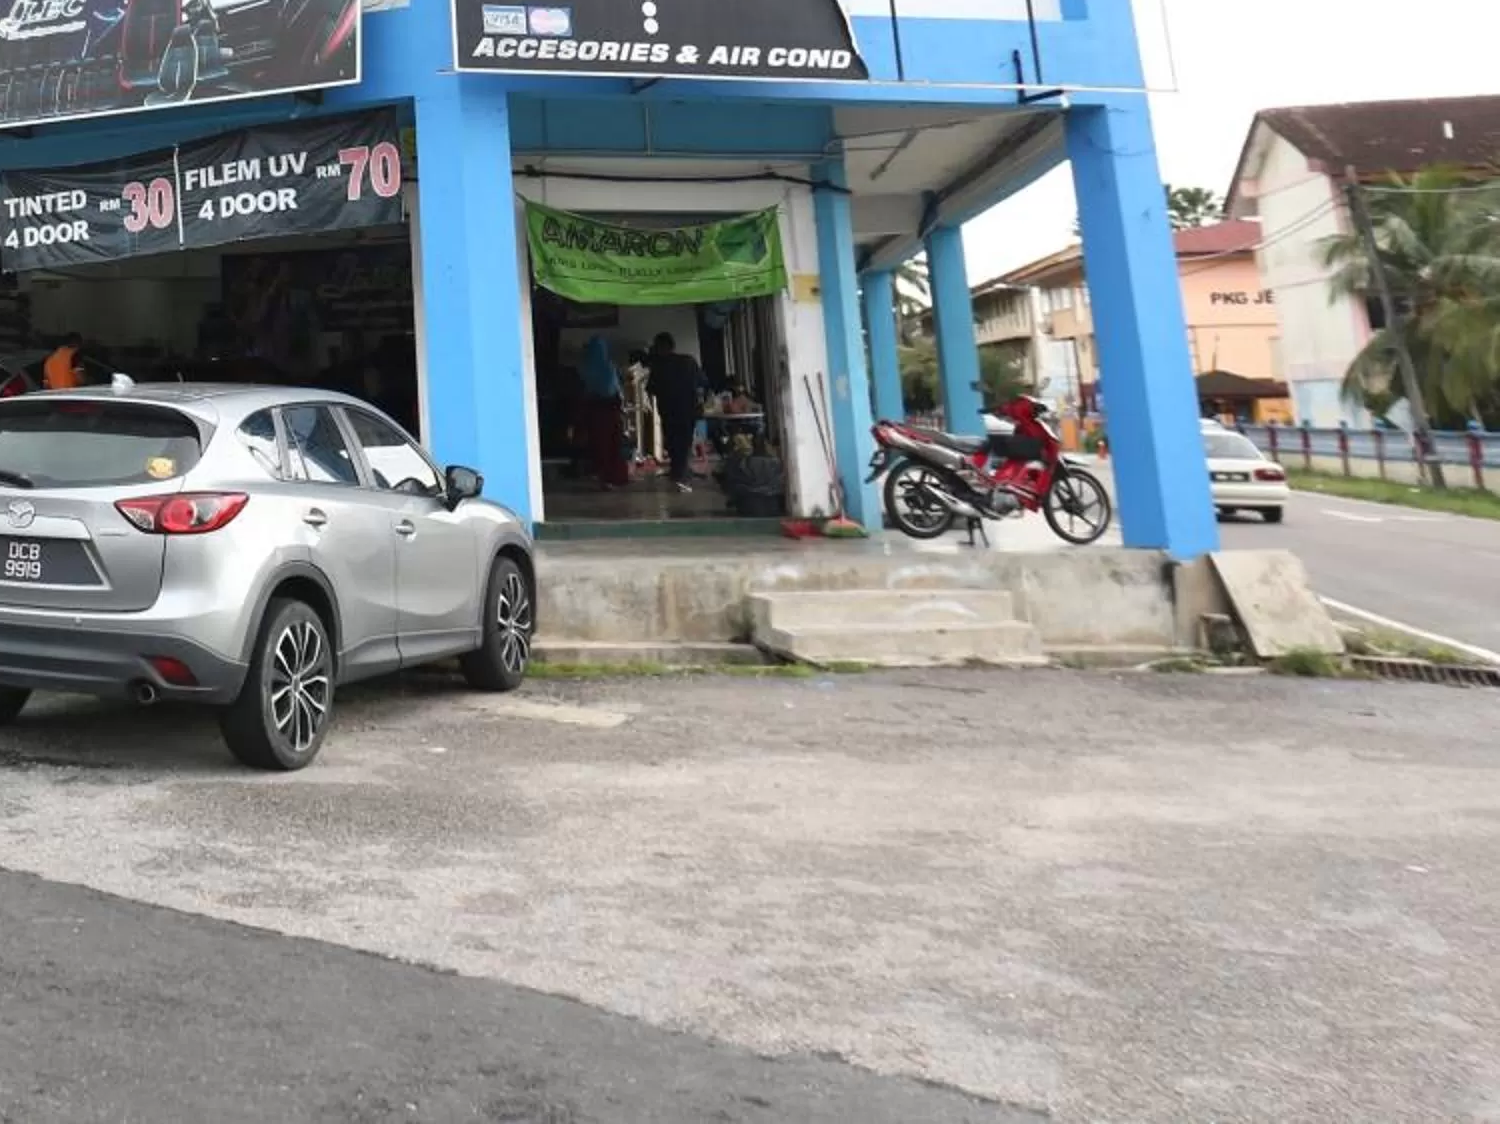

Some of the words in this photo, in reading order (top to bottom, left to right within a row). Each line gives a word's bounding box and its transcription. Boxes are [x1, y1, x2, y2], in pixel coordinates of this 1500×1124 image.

[472, 37, 671, 64] ACCESORIES
[675, 44, 700, 64] &
[707, 46, 762, 67] AIR
[766, 47, 852, 70] COND
[185, 160, 262, 192] FILEM
[268, 151, 309, 178] UV
[316, 163, 341, 180] RM
[338, 141, 401, 202] 70
[3, 189, 88, 220] TINTED
[100, 198, 121, 214] RM
[122, 177, 175, 233] 30
[198, 200, 215, 222] 4
[218, 187, 299, 220] DOOR
[4, 230, 20, 250] 4
[22, 220, 91, 249] DOOR
[1209, 291, 1249, 305] PKG
